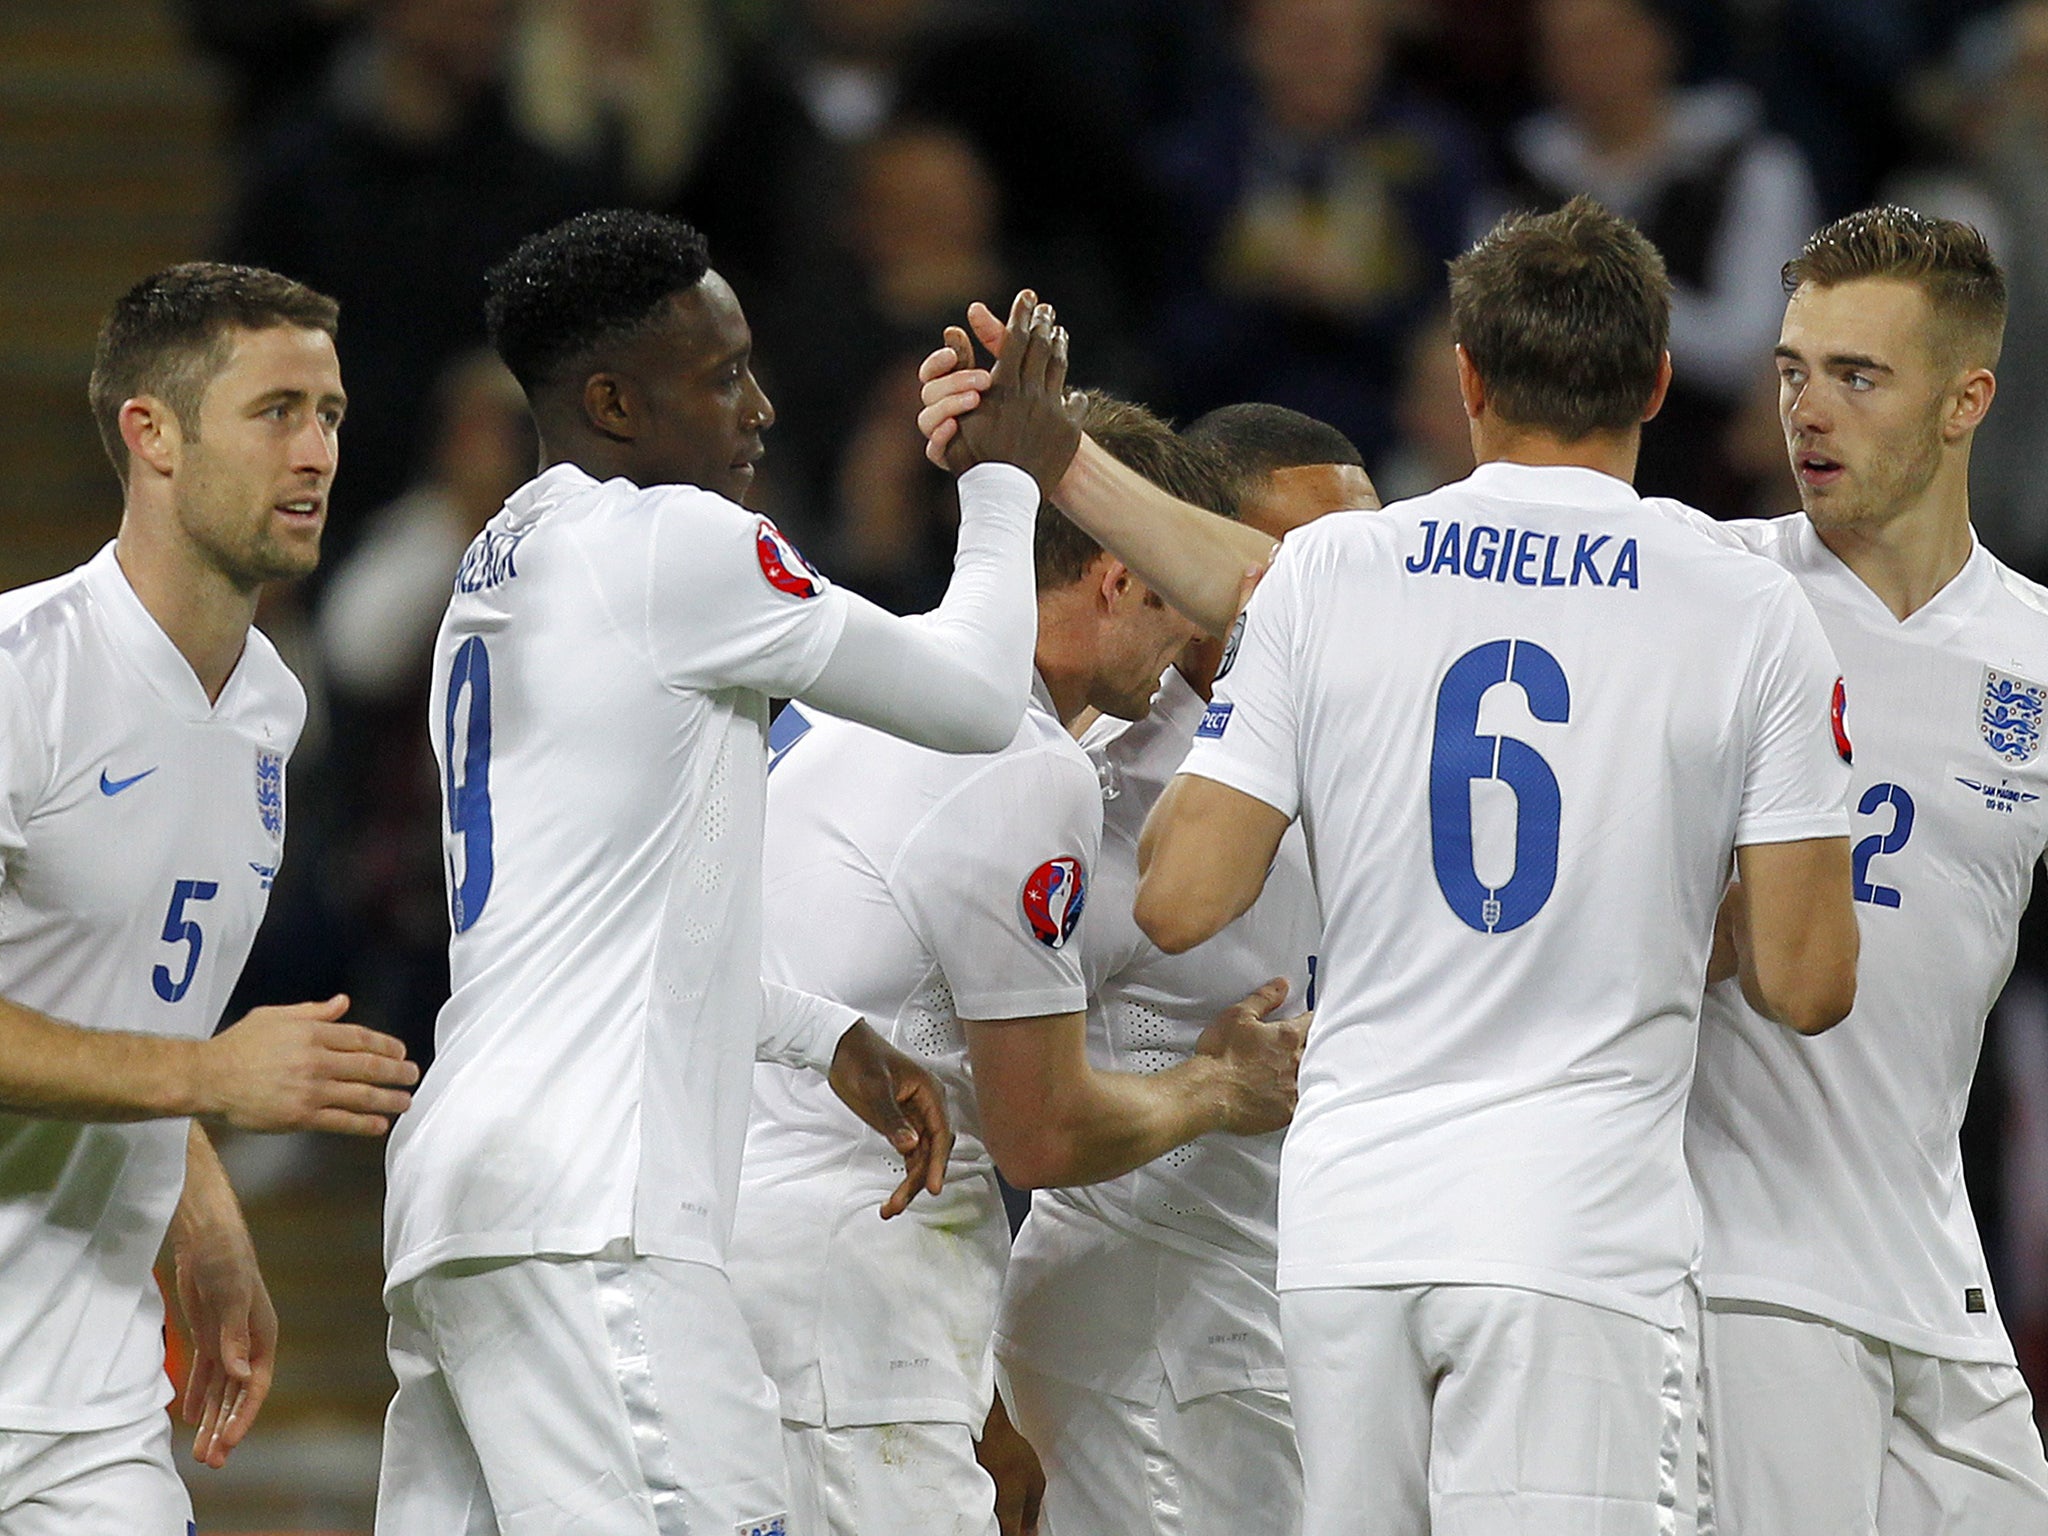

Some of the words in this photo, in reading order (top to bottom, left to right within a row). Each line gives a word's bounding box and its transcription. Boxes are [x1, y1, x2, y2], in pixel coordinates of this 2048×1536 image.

[1405, 520, 1639, 590] JAGIELKA
[446, 635, 493, 934] 9
[1430, 639, 1570, 934] 6
[1852, 782, 1915, 909] 2
[152, 880, 219, 1003] 5
